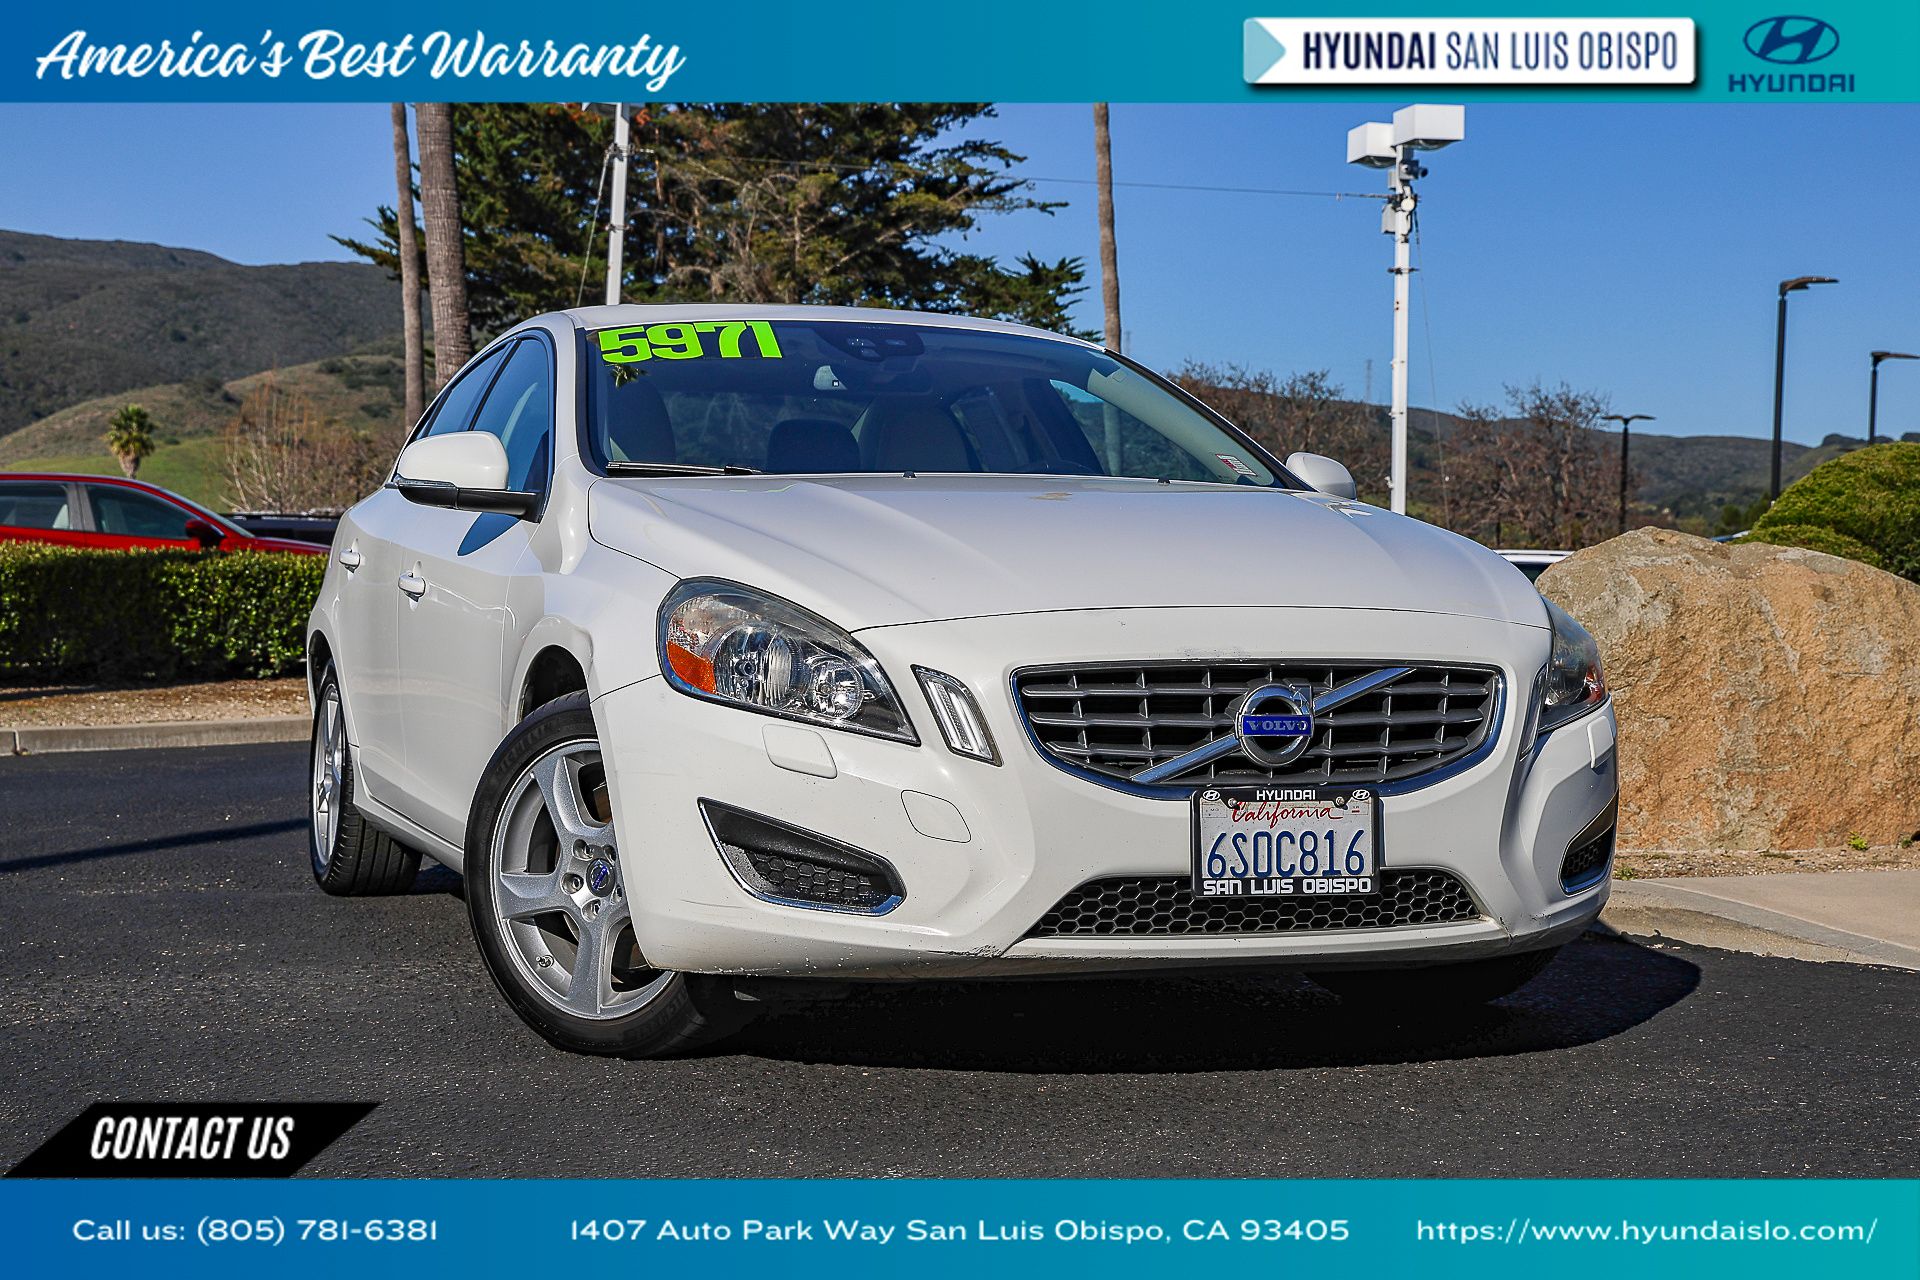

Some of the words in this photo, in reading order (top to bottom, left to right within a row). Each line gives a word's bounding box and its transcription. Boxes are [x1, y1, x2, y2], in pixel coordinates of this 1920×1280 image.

[599, 321, 782, 363] 5971
[1246, 720, 1308, 731] VOLVO
[1256, 790, 1315, 800] HYUNDAI
[1232, 801, 1343, 828] California
[1207, 829, 1365, 878] 6SOC816
[1203, 880, 1242, 895] SAN
[1251, 879, 1293, 894] LUIS
[1303, 878, 1371, 893] OBISPO
